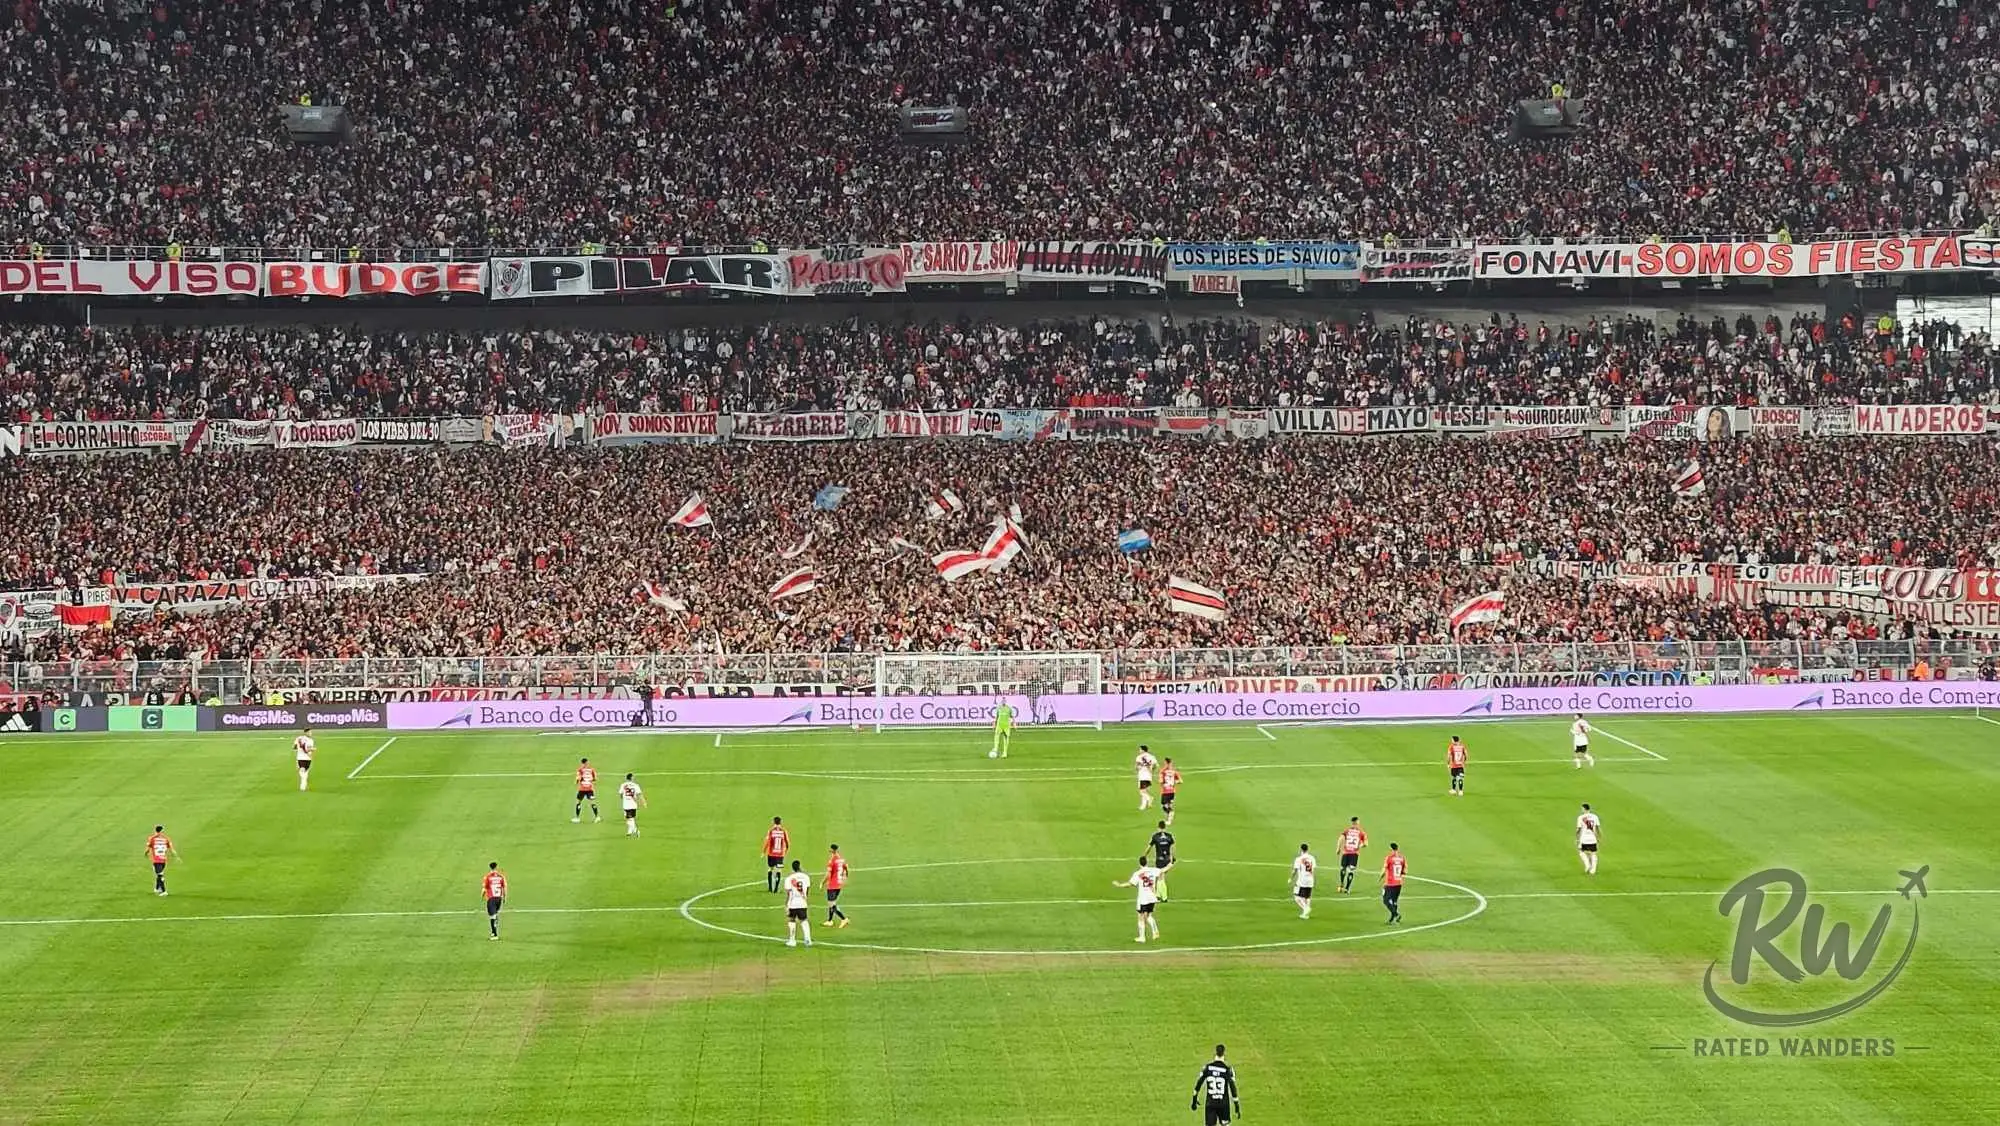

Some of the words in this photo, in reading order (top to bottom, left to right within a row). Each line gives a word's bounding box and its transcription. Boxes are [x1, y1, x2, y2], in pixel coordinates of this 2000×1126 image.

[1174, 248, 1206, 265] LOS
[1211, 248, 1259, 266] PIBES
[1265, 248, 1285, 265] DE
[1291, 248, 1341, 266] SAVIO
[1381, 252, 1408, 263] LAS
[1480, 249, 1620, 275] FONAVI
[1636, 243, 1792, 275] SOMOS
[1809, 235, 1961, 273] FIESTA
[0, 262, 102, 292] DEL
[129, 263, 257, 293] VISO
[269, 264, 481, 296] BUDGE
[529, 257, 774, 293] PILAR
[629, 416, 672, 433] SOMOS
[674, 415, 717, 434] RIVER
[974, 411, 1001, 432] JCP
[1275, 409, 1335, 430] VILLA
[1343, 412, 1365, 431] DE
[1368, 408, 1427, 429] MAYO
[1440, 407, 1490, 426] TESEI
[1518, 408, 1587, 425] SOURDEAUX
[1857, 407, 1985, 432] MATADEROS
[33, 426, 50, 449] EL
[55, 424, 140, 448] CORRALITO
[362, 421, 379, 440] LOS
[1677, 563, 1769, 579] PACHECO
[1778, 566, 1835, 584] GARIN
[140, 583, 241, 604] CARAZA
[1764, 589, 1825, 607] VILLA
[1834, 592, 1890, 614] ELISA
[1907, 602, 2000, 625] BALLESTE
[1501, 694, 1563, 711] Banco
[1573, 692, 1593, 710] de
[1597, 691, 1693, 710] Comercio
[1832, 688, 1894, 705] Banco
[1900, 687, 1923, 704] de
[480, 706, 544, 724] Banco
[549, 705, 573, 723] de
[820, 703, 884, 721] Banco
[889, 702, 915, 720] de
[1163, 699, 1236, 717] Banco
[1238, 698, 1257, 716] de
[1269, 698, 1360, 716] Comercio
[1206, 1076, 1226, 1095] 33
